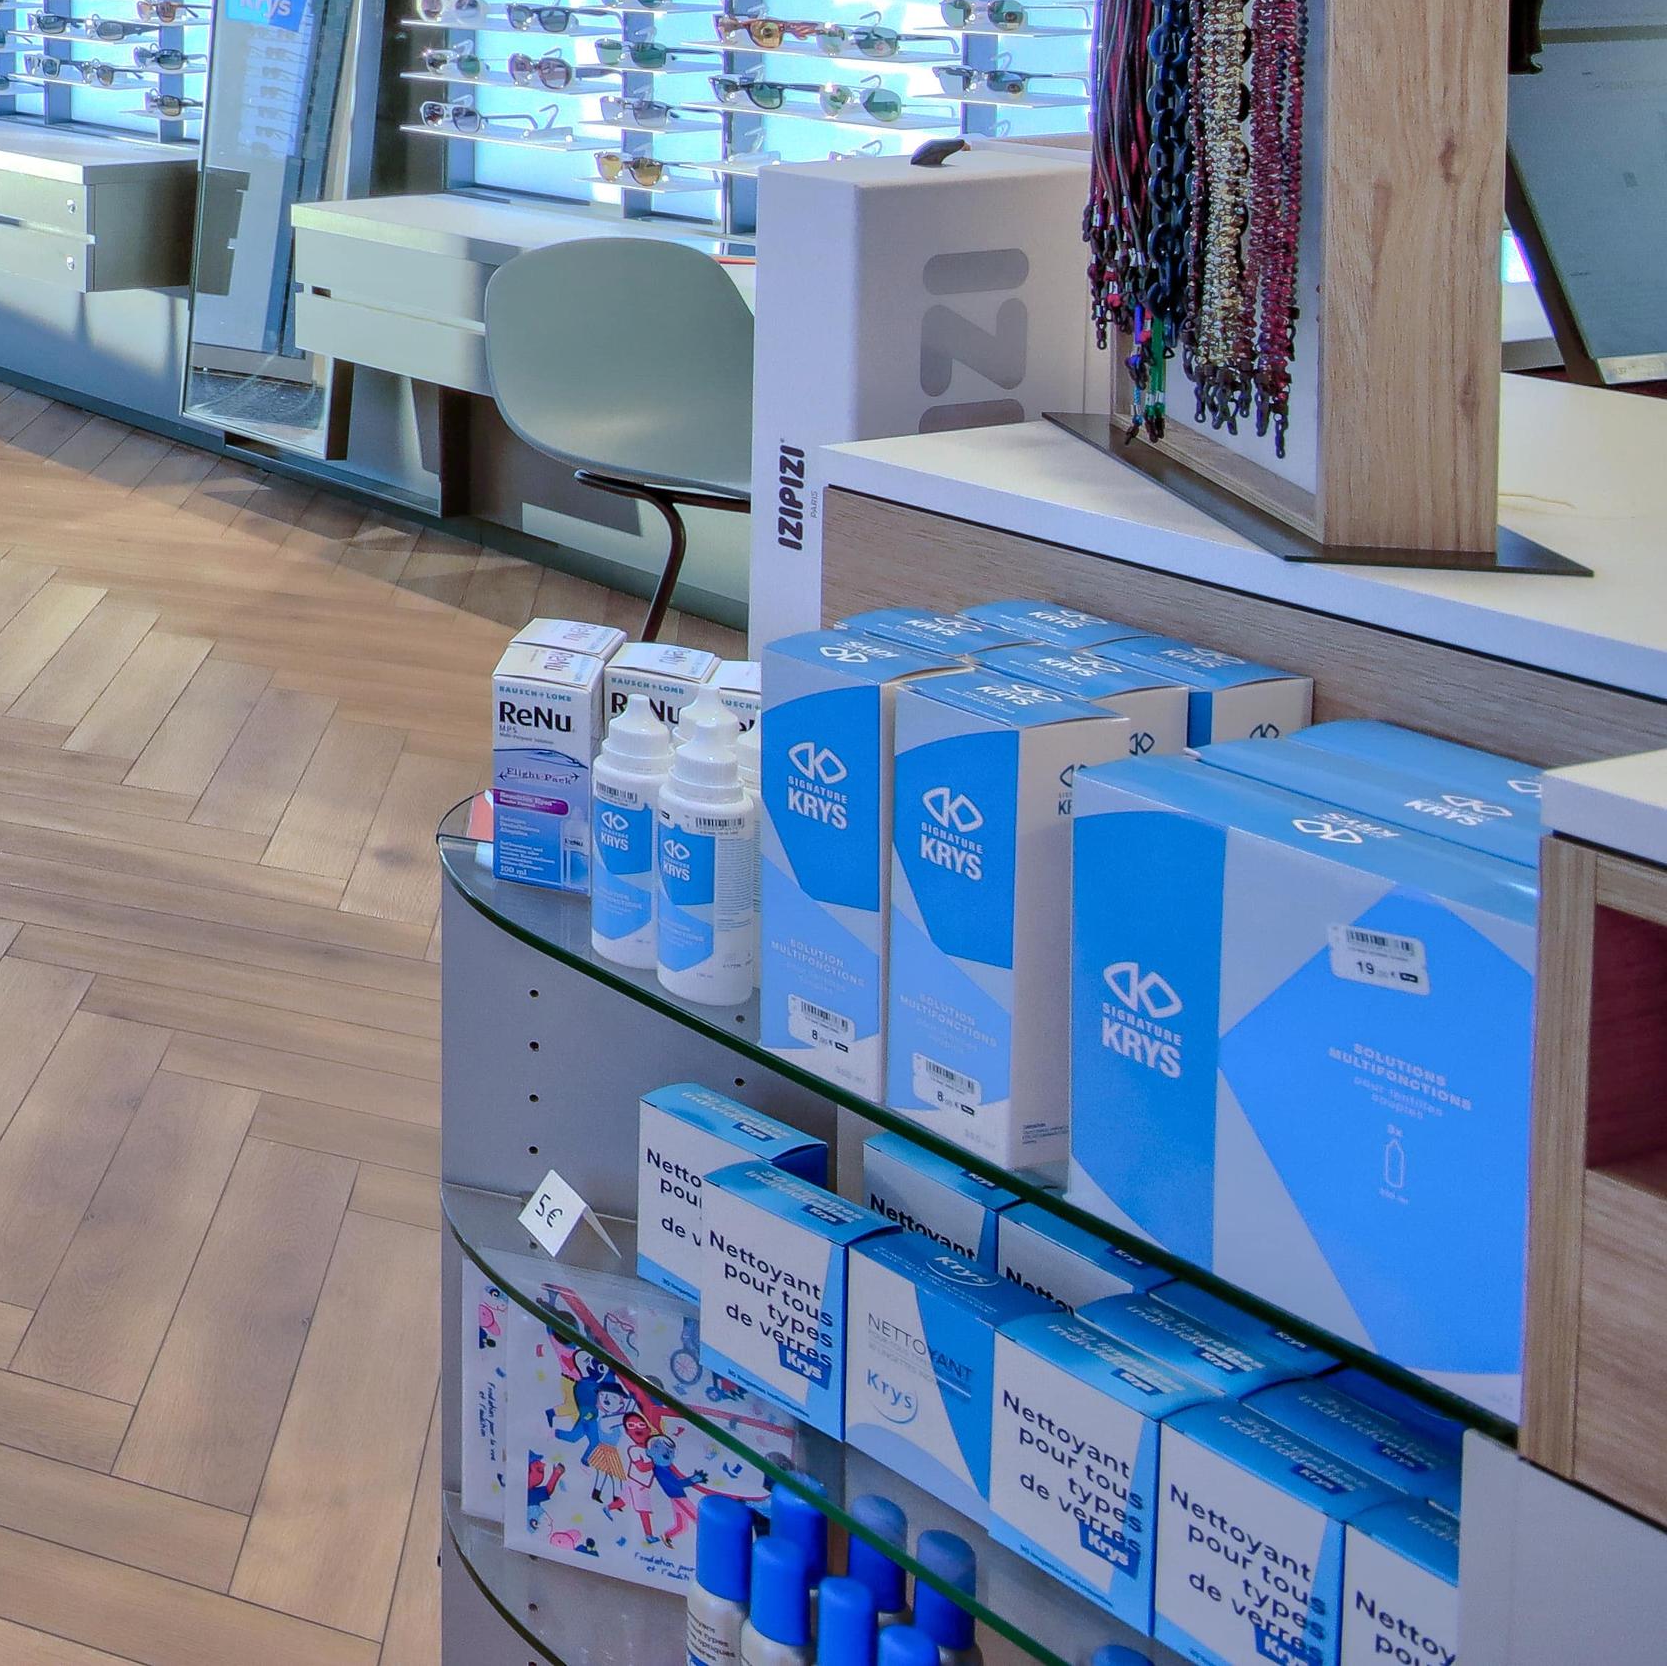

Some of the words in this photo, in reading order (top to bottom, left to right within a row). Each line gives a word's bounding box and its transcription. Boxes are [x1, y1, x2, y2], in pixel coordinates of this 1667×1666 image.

[778, 445, 805, 551] IZIPIZI
[810, 490, 819, 520] PARIS
[499, 686, 538, 697] BAUSCH
[546, 693, 572, 702] LOMB
[611, 677, 650, 689] BAUSCH
[658, 684, 684, 695] LOMB
[720, 698, 752, 710] USCH
[976, 685, 1030, 705] KRYS
[499, 701, 571, 733] ReNu
[611, 692, 679, 725] RNu
[788, 775, 848, 804] SIGNATURE
[788, 786, 848, 830] KRYS
[601, 832, 629, 851] KRYS
[921, 821, 983, 855] SIGNATURE
[921, 834, 983, 881] KRYS
[662, 864, 690, 881] KRYS
[789, 938, 844, 967] SOLUTION
[920, 993, 976, 1026] SOLUTION
[1102, 1002, 1182, 1045] SIGNATURE
[1101, 1020, 1182, 1080] KRYS
[1354, 1043, 1447, 1086] SOLUTIONS
[1328, 1047, 1472, 1111] MULTIFONCTIONS
[647, 1148, 701, 1188] Netto
[535, 1193, 563, 1228] 5€
[661, 1217, 686, 1238] de
[710, 1230, 821, 1300] Nettoyant
[934, 1255, 989, 1284] Krys
[725, 1262, 776, 1297] pour
[782, 1290, 833, 1327] tous
[1006, 1266, 1070, 1314] Netto
[726, 1304, 752, 1327] de
[760, 1321, 833, 1366] verres
[767, 1304, 833, 1349] types
[867, 1313, 973, 1379] NETTOYANT
[786, 1350, 823, 1380] Krys
[867, 1369, 914, 1410] Krys
[1003, 1389, 1130, 1479] Nettoyant
[1019, 1427, 1078, 1469] pour
[1085, 1464, 1144, 1510] tous
[1020, 1473, 1050, 1500] de
[1058, 1496, 1141, 1553] verres
[1068, 1477, 1142, 1533] types
[1087, 1533, 1129, 1566] Krys
[1169, 1484, 1312, 1583] Nettoyant
[1188, 1524, 1254, 1571] pour
[1261, 1565, 1326, 1616] tous
[1188, 1572, 1222, 1602] de
[1231, 1597, 1323, 1661] verres
[1243, 1579, 1326, 1640] types
[1355, 1590, 1457, 1666] Nettoy
